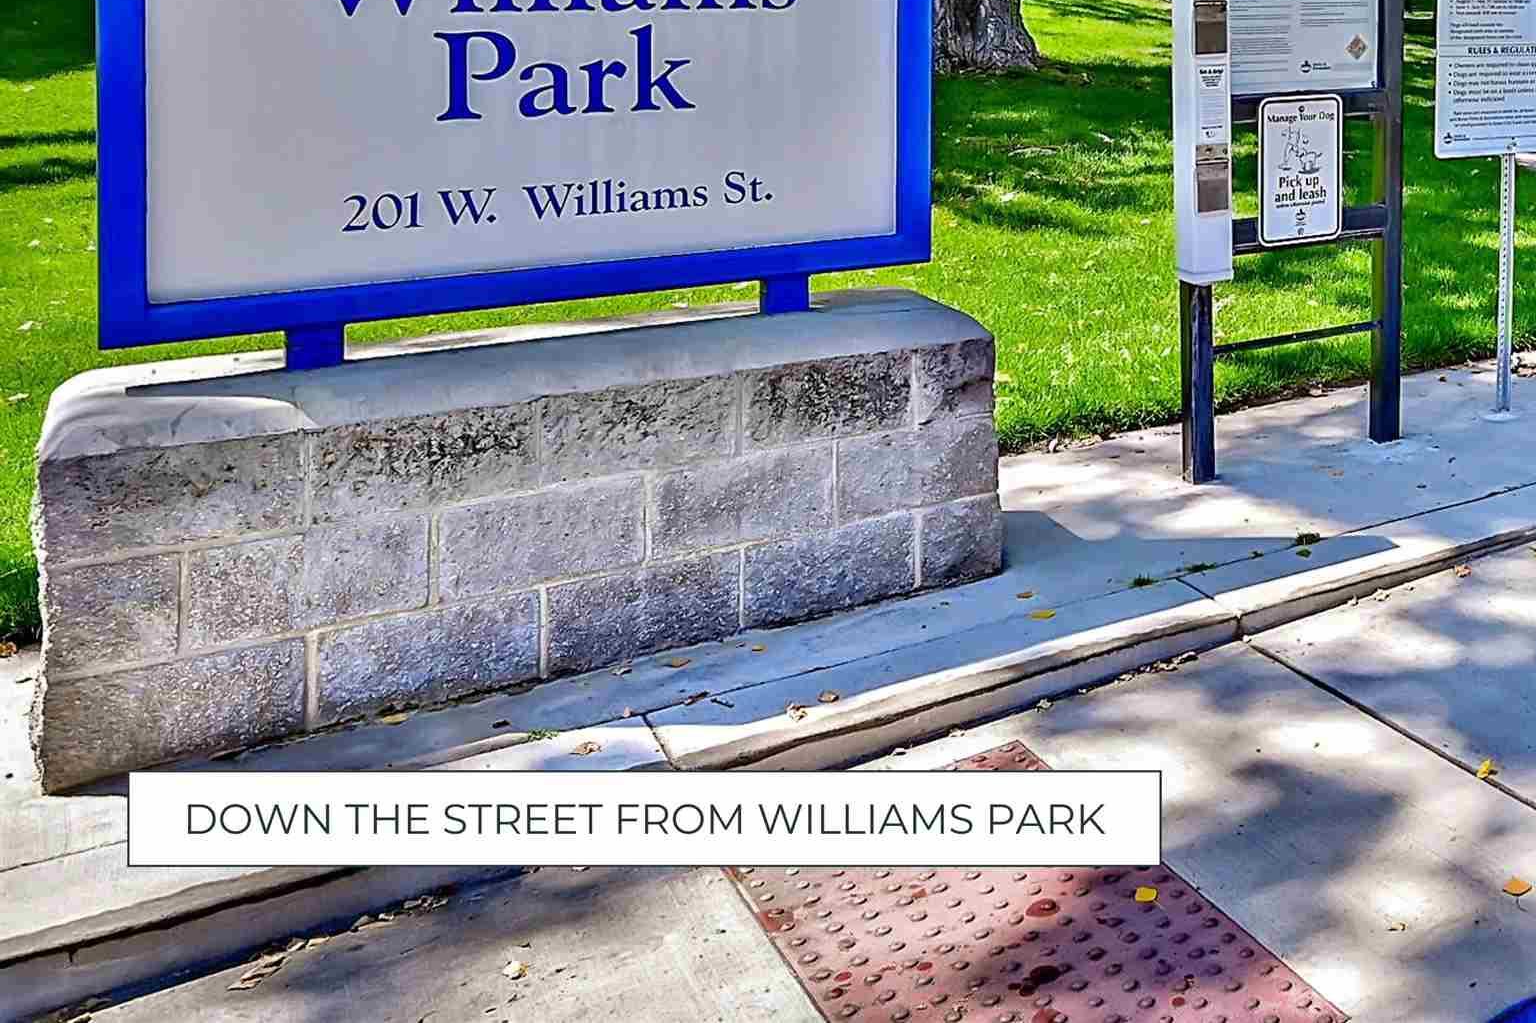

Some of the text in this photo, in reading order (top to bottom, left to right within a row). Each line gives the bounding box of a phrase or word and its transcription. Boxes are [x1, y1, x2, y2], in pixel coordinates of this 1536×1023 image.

[1467, 46, 1492, 55] RULES
[433, 23, 697, 122] Park
[1279, 175, 1319, 189] Pick up
[341, 171, 773, 233] 201 W. Williams St.
[1274, 186, 1327, 203] and leash
